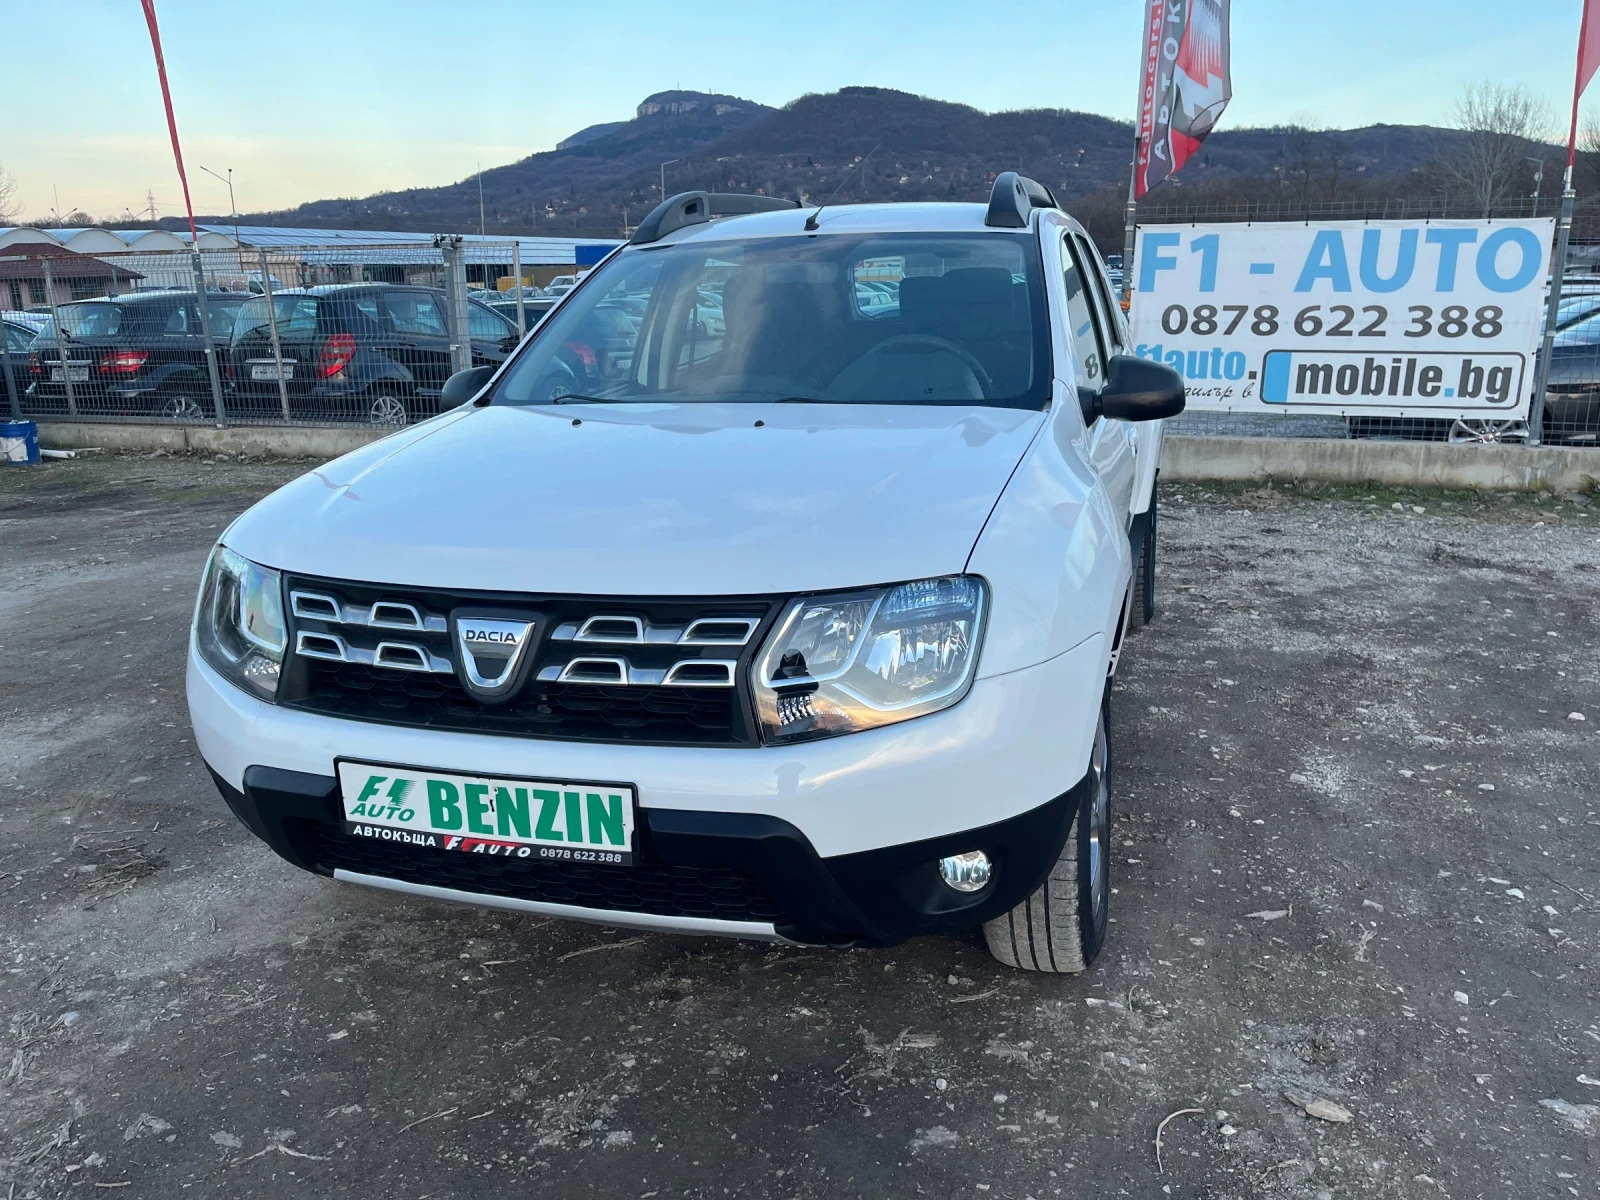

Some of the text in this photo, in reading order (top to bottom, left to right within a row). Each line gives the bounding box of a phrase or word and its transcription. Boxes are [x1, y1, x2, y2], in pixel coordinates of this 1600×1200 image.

[1138, 232, 1219, 293] F1
[1294, 226, 1543, 294] AUTO
[1161, 304, 1503, 339] 0878 622 388
[1295, 357, 1513, 403] mobile.bg
[465, 629, 517, 643] DACIA
[349, 802, 415, 822] AUTO
[357, 775, 625, 846] F1 BENZIN
[353, 825, 436, 847] АВТОКЪЩА
[473, 843, 531, 858] AUTO
[540, 848, 571, 859] 0878
[574, 851, 596, 862] 622
[598, 852, 622, 864] 388
